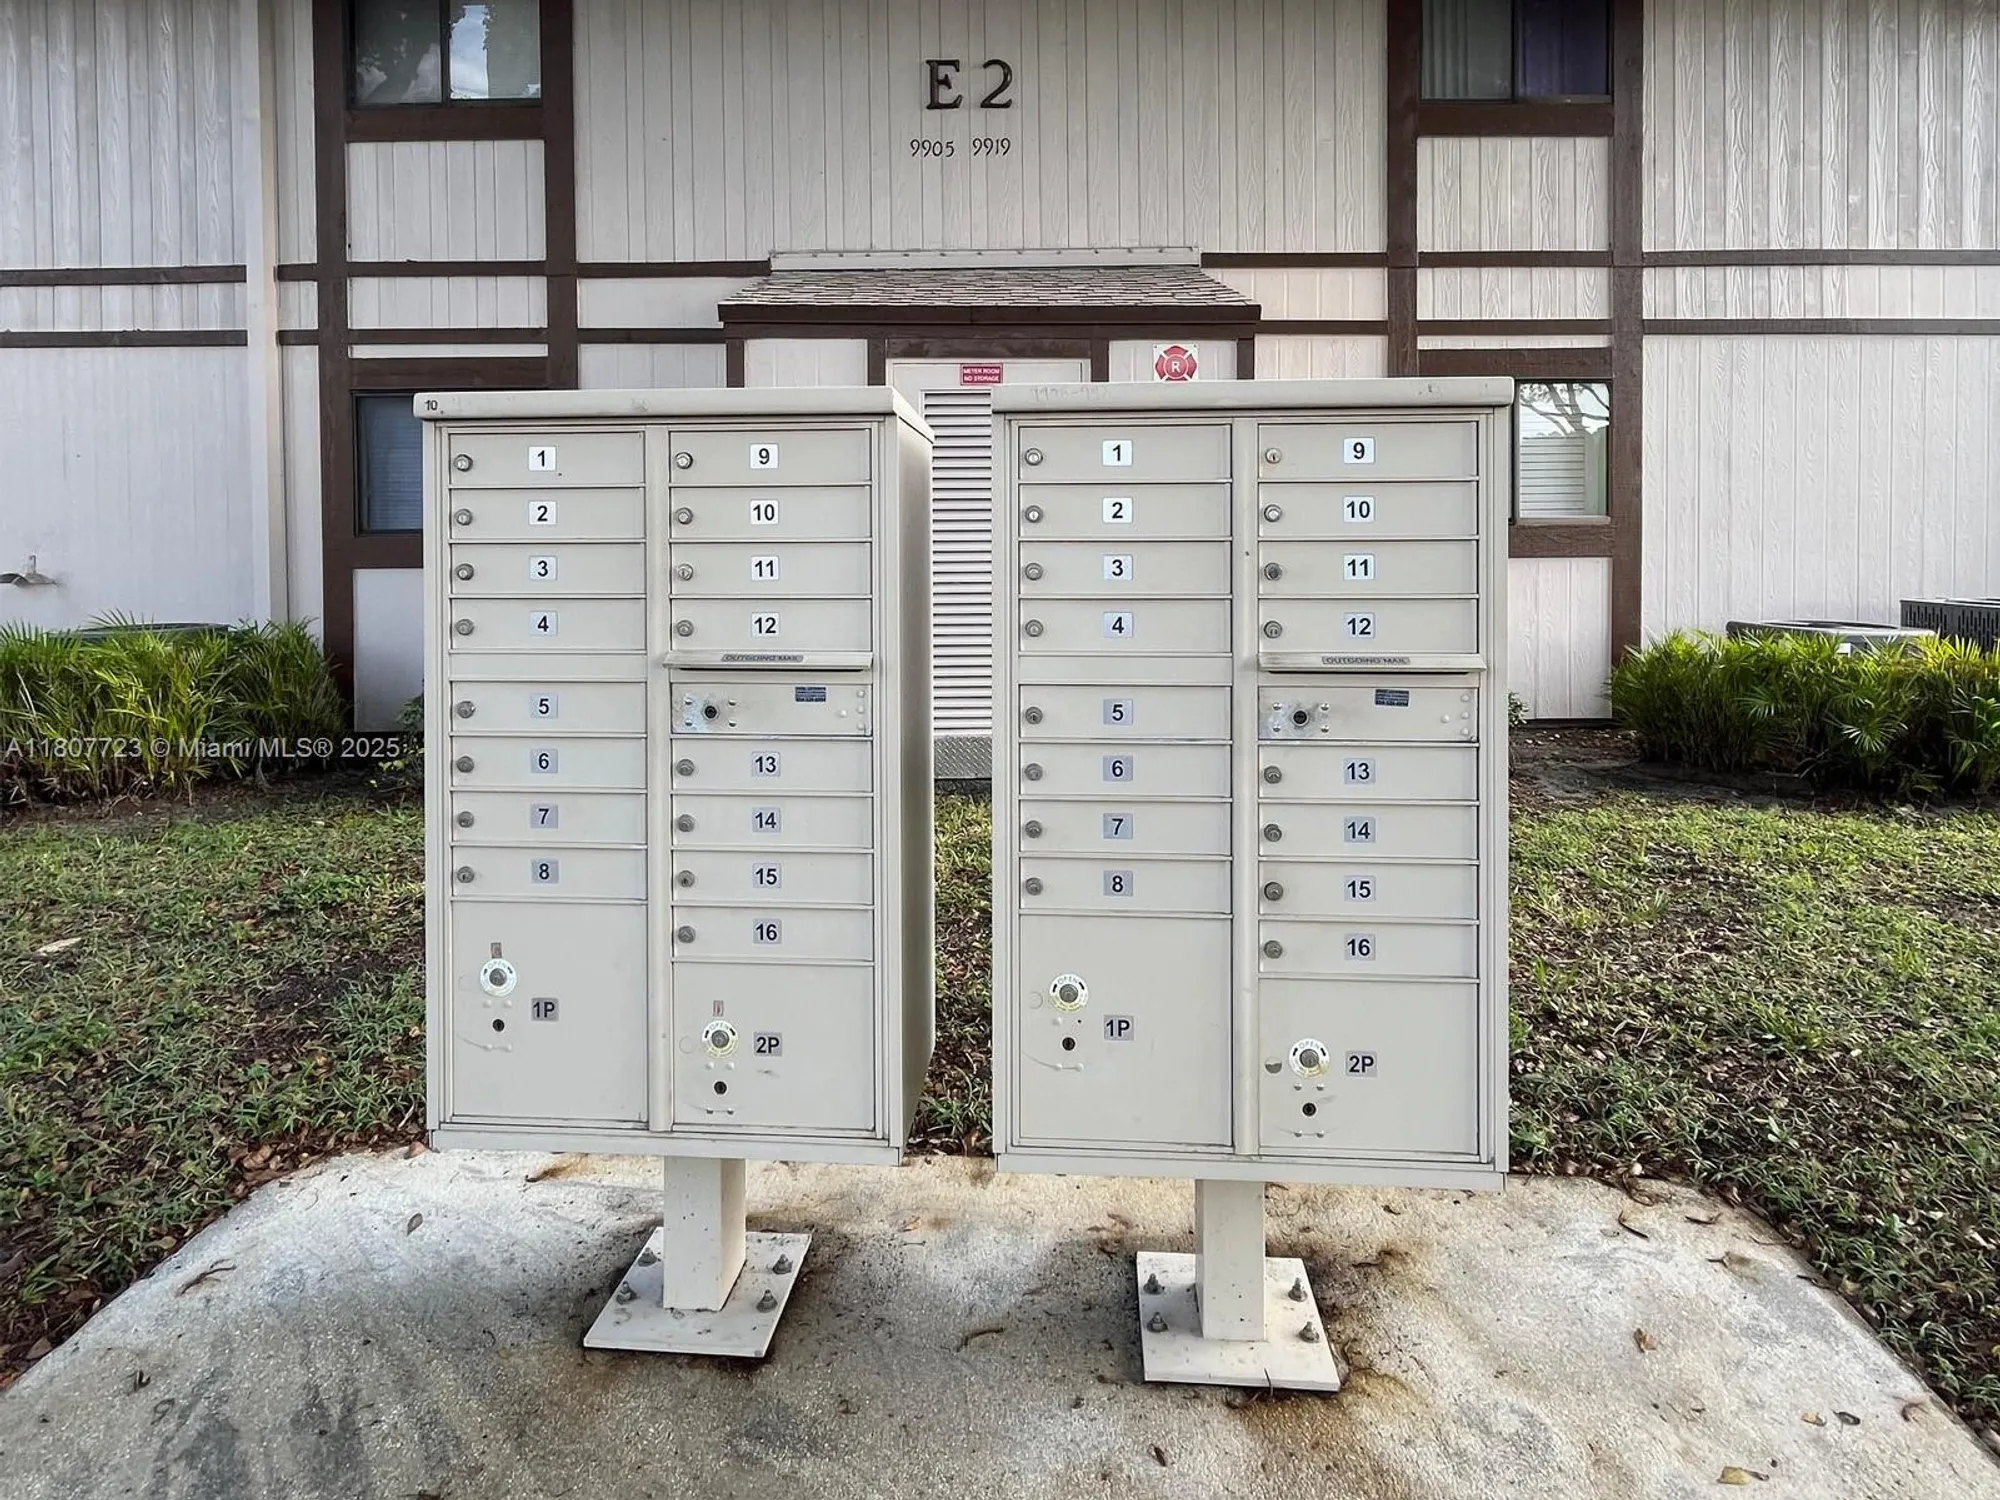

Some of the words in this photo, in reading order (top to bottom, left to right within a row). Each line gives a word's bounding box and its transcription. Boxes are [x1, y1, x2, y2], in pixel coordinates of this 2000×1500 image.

[925, 59, 963, 110] E
[980, 58, 1013, 109] 2
[909, 138, 955, 158] 9905
[972, 137, 1011, 157] 9919
[1171, 360, 1181, 373] R
[537, 450, 545, 467] 1
[758, 448, 770, 465] 9
[1112, 444, 1121, 461] 1
[1353, 442, 1365, 460] 9
[537, 505, 548, 522] 2
[753, 504, 775, 521] 10
[1112, 502, 1123, 519] 2
[1346, 500, 1370, 519] 10
[537, 560, 549, 577] 3
[754, 560, 774, 577] 11
[1112, 559, 1124, 577] 3
[1347, 558, 1368, 577] 11
[537, 615, 549, 632] 4
[754, 617, 776, 634] 12
[1111, 616, 1125, 634] 4
[1347, 617, 1371, 635] 12
[538, 698, 550, 715] 5
[1112, 704, 1124, 722] 5
[538, 752, 550, 770] 6
[755, 756, 776, 773] 13
[1111, 760, 1124, 778] 6
[1347, 762, 1370, 780] 13
[538, 808, 550, 825] 7
[755, 812, 777, 829] 14
[1111, 818, 1124, 836] 7
[1347, 821, 1371, 840] 14
[538, 863, 550, 880] 8
[755, 867, 778, 885] 15
[1111, 875, 1124, 893] 8
[1347, 880, 1371, 899] 15
[755, 923, 778, 941] 16
[1347, 938, 1371, 957] 16
[532, 1001, 555, 1018] 1P
[1106, 1019, 1130, 1037] 1P
[756, 1036, 780, 1054] 2P
[1349, 1055, 1374, 1073] 2P
